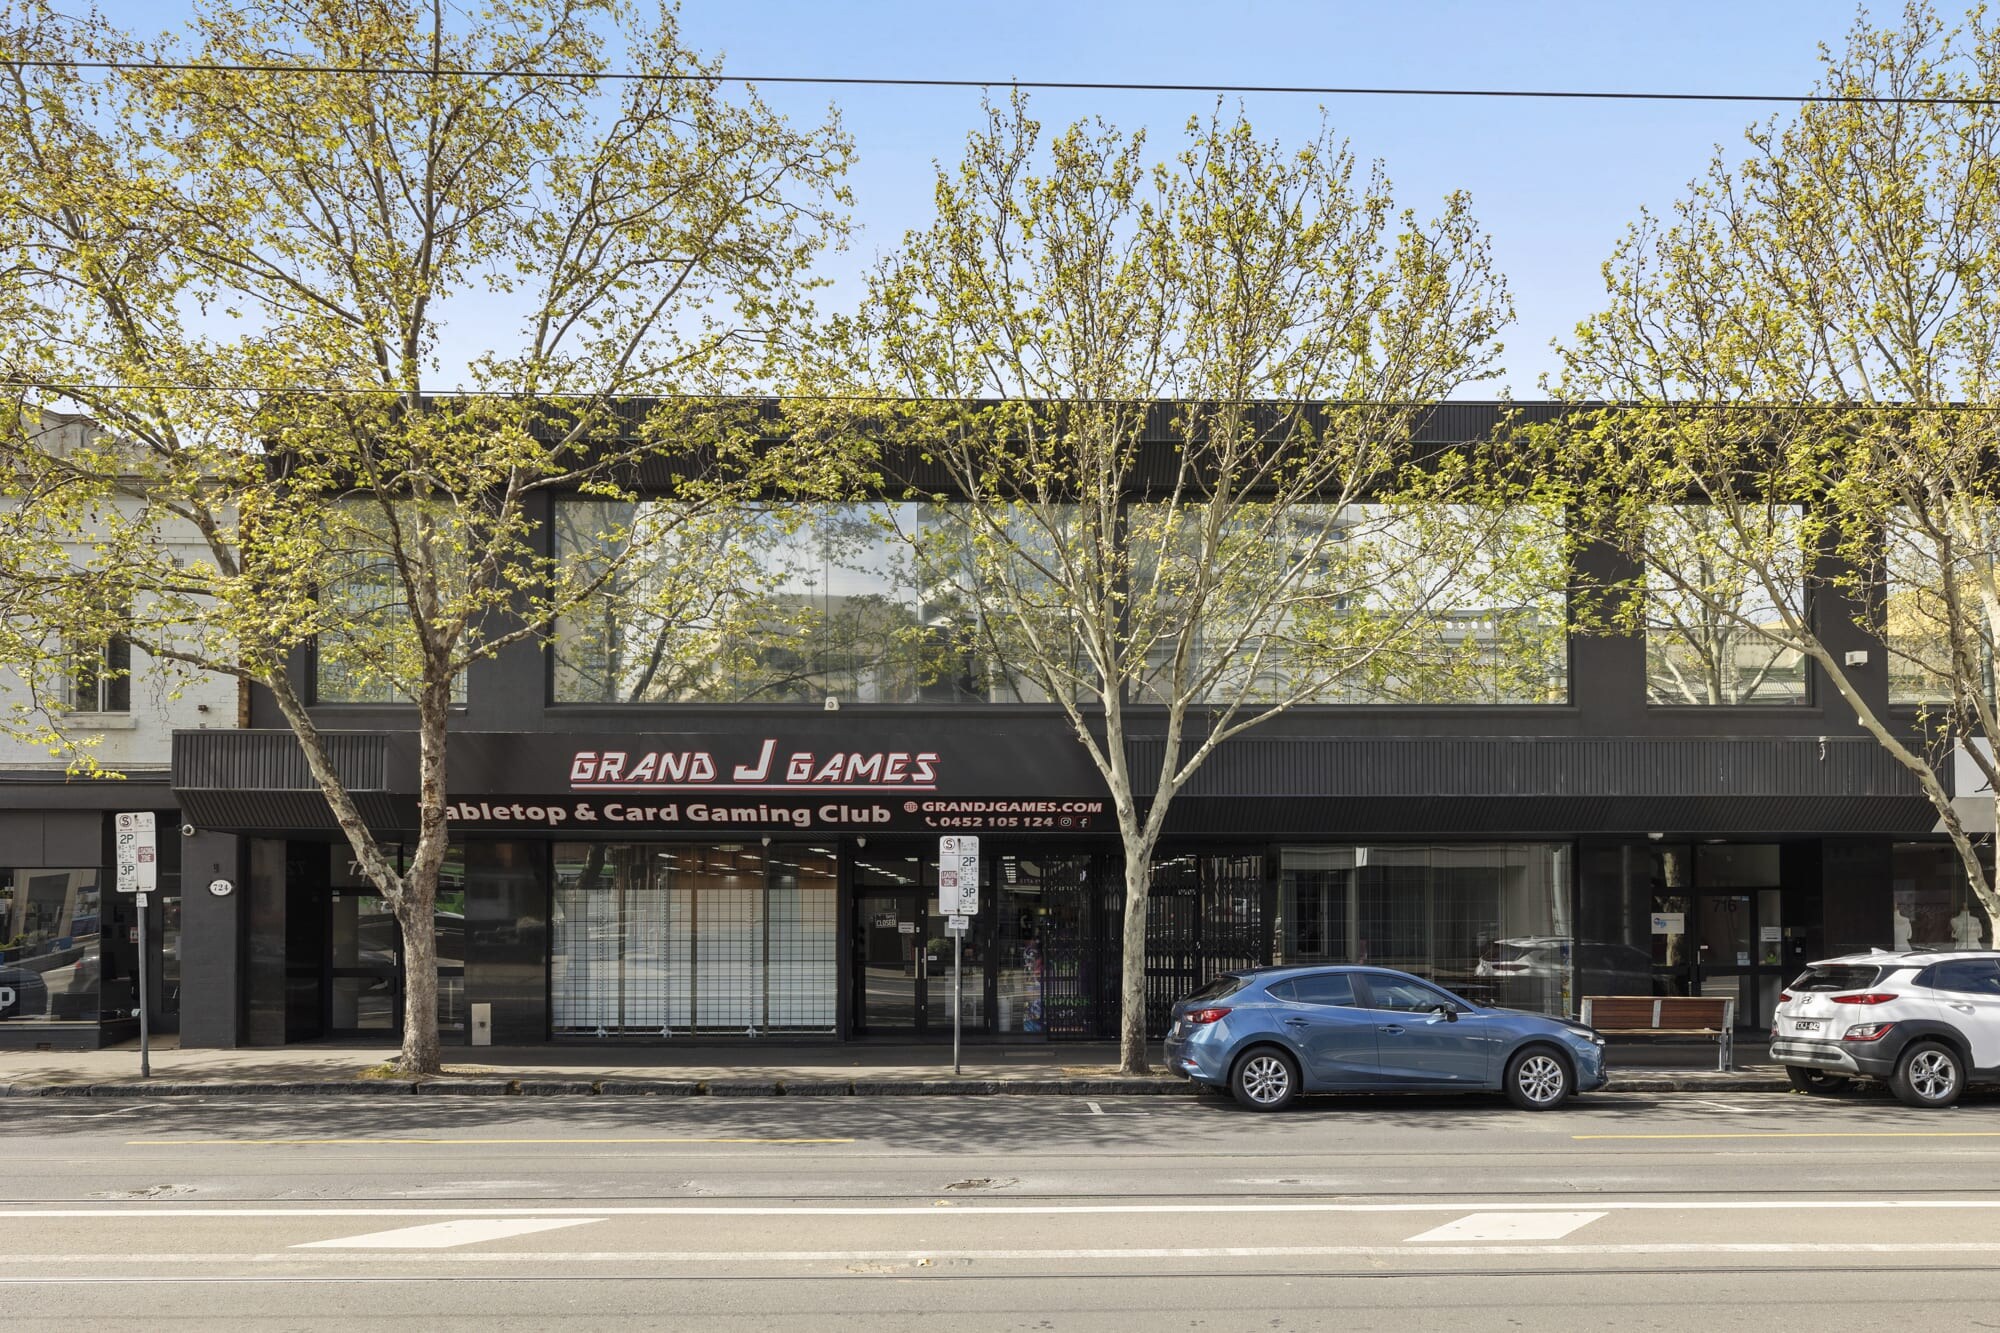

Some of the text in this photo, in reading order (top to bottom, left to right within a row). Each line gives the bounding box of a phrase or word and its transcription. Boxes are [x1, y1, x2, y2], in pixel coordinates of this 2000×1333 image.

[570, 739, 941, 783] GRAND J GAMES
[922, 801, 1102, 813] GRANDJGAMES.COM
[417, 803, 891, 827] abletop & Card Gaming Club
[940, 817, 1054, 827] 0452 105 124
[119, 834, 134, 844] 2P
[962, 856, 976, 867] 2P
[120, 865, 135, 876] 3P
[212, 883, 229, 891] 724
[962, 887, 976, 898] 3P
